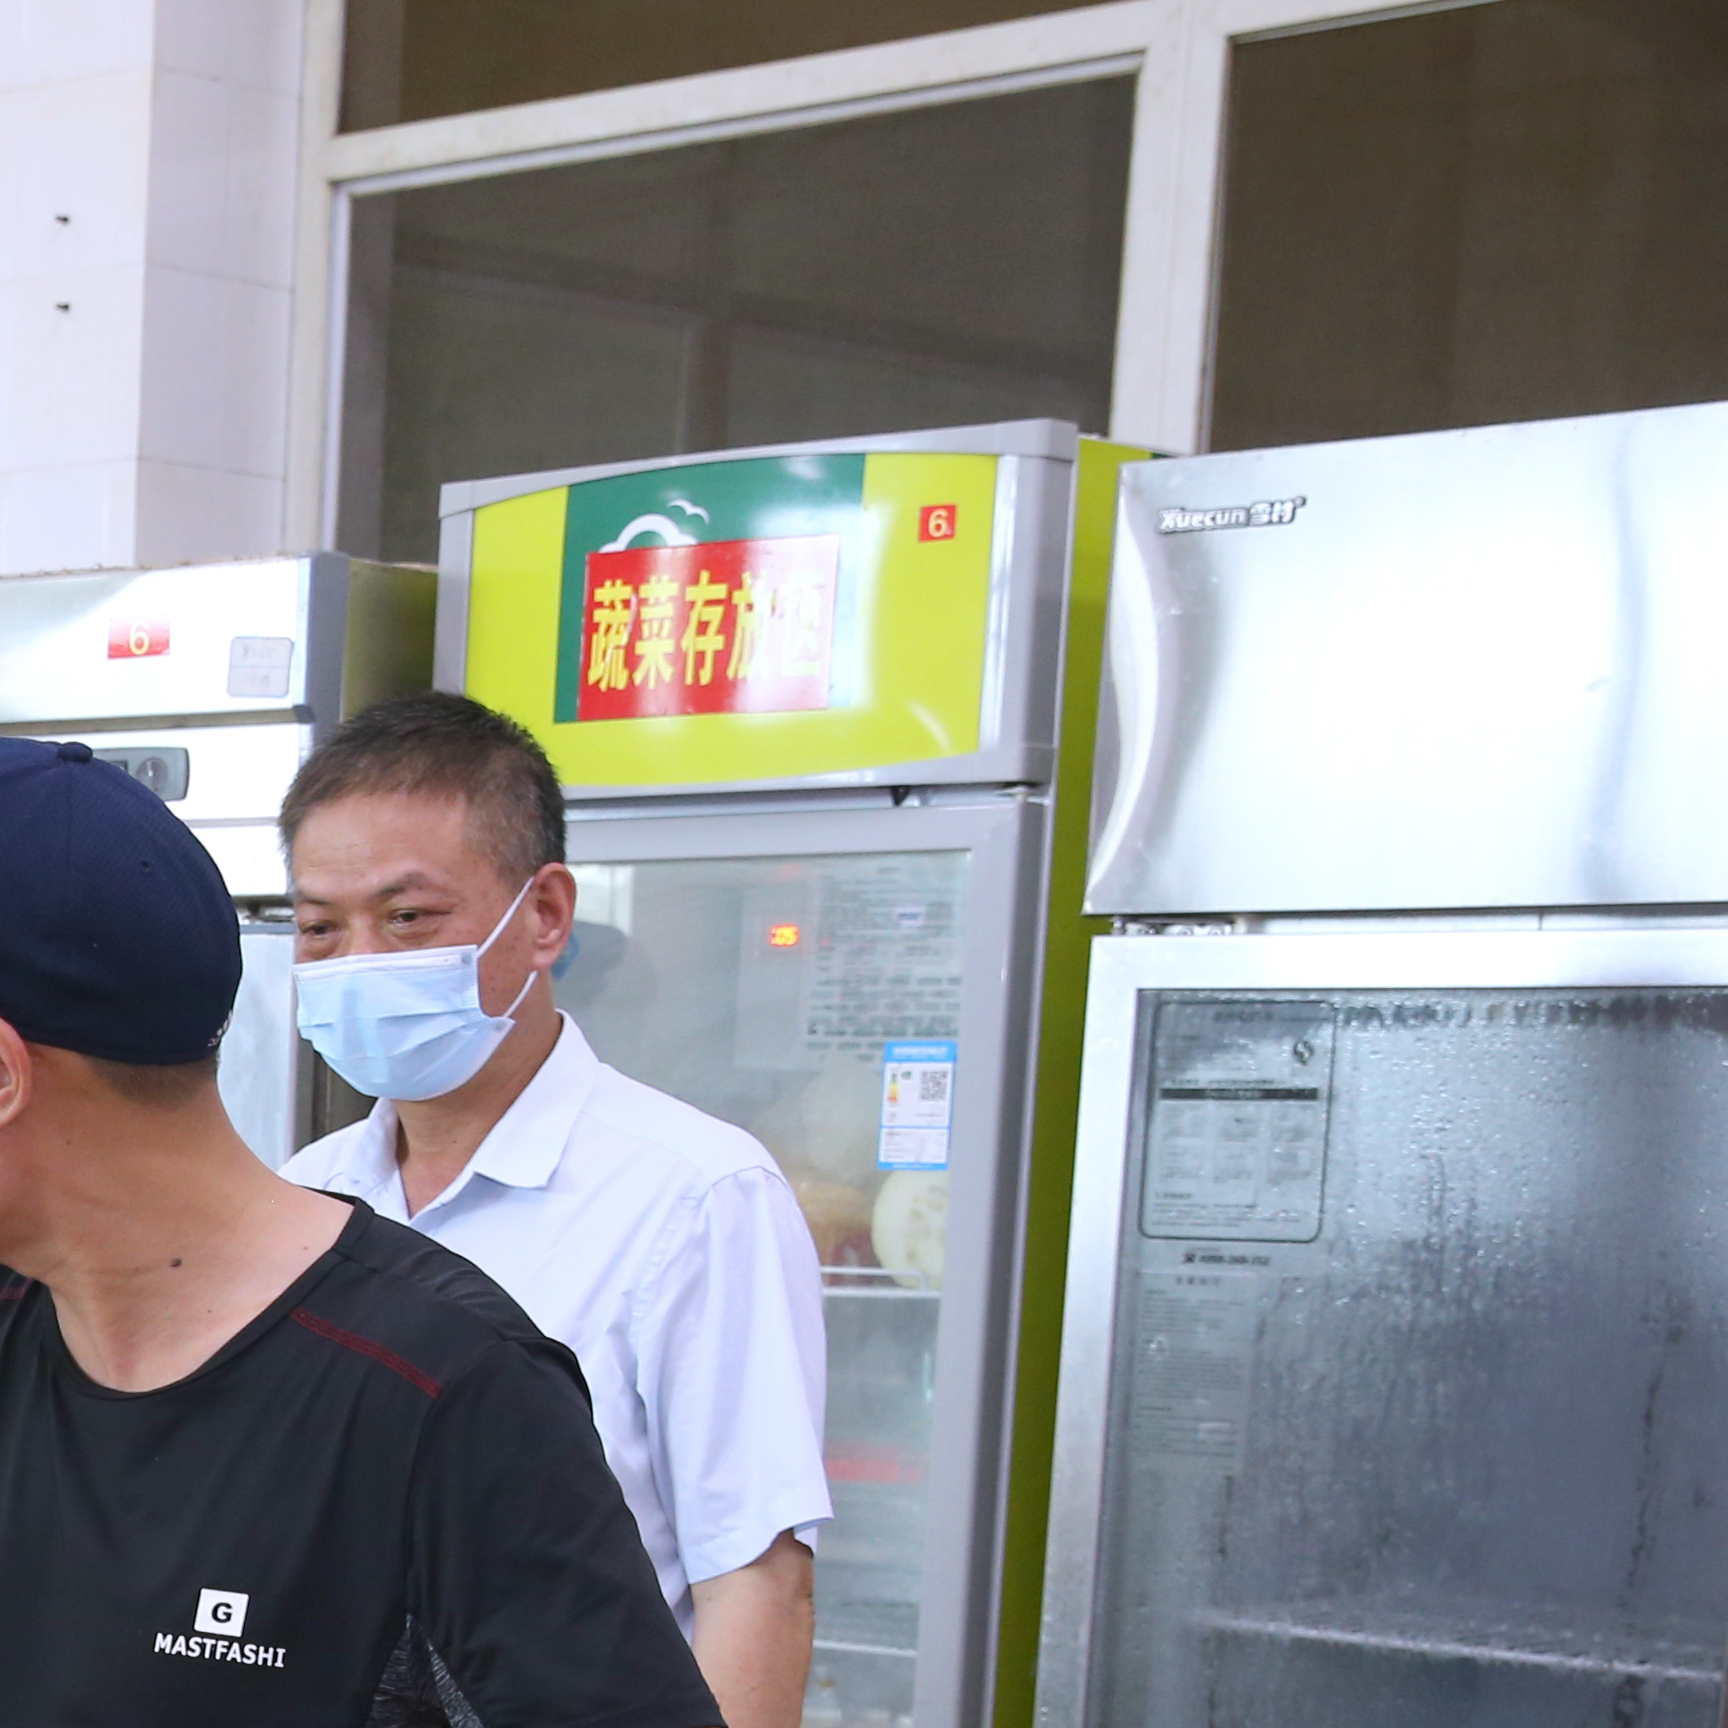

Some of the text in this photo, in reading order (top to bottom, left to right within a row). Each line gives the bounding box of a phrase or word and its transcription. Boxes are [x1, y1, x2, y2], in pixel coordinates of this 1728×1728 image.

[928, 508, 949, 537] 6
[129, 621, 151, 656] 6
[211, 1602, 233, 1624] G
[154, 1633, 286, 1668] MASTFASHI
